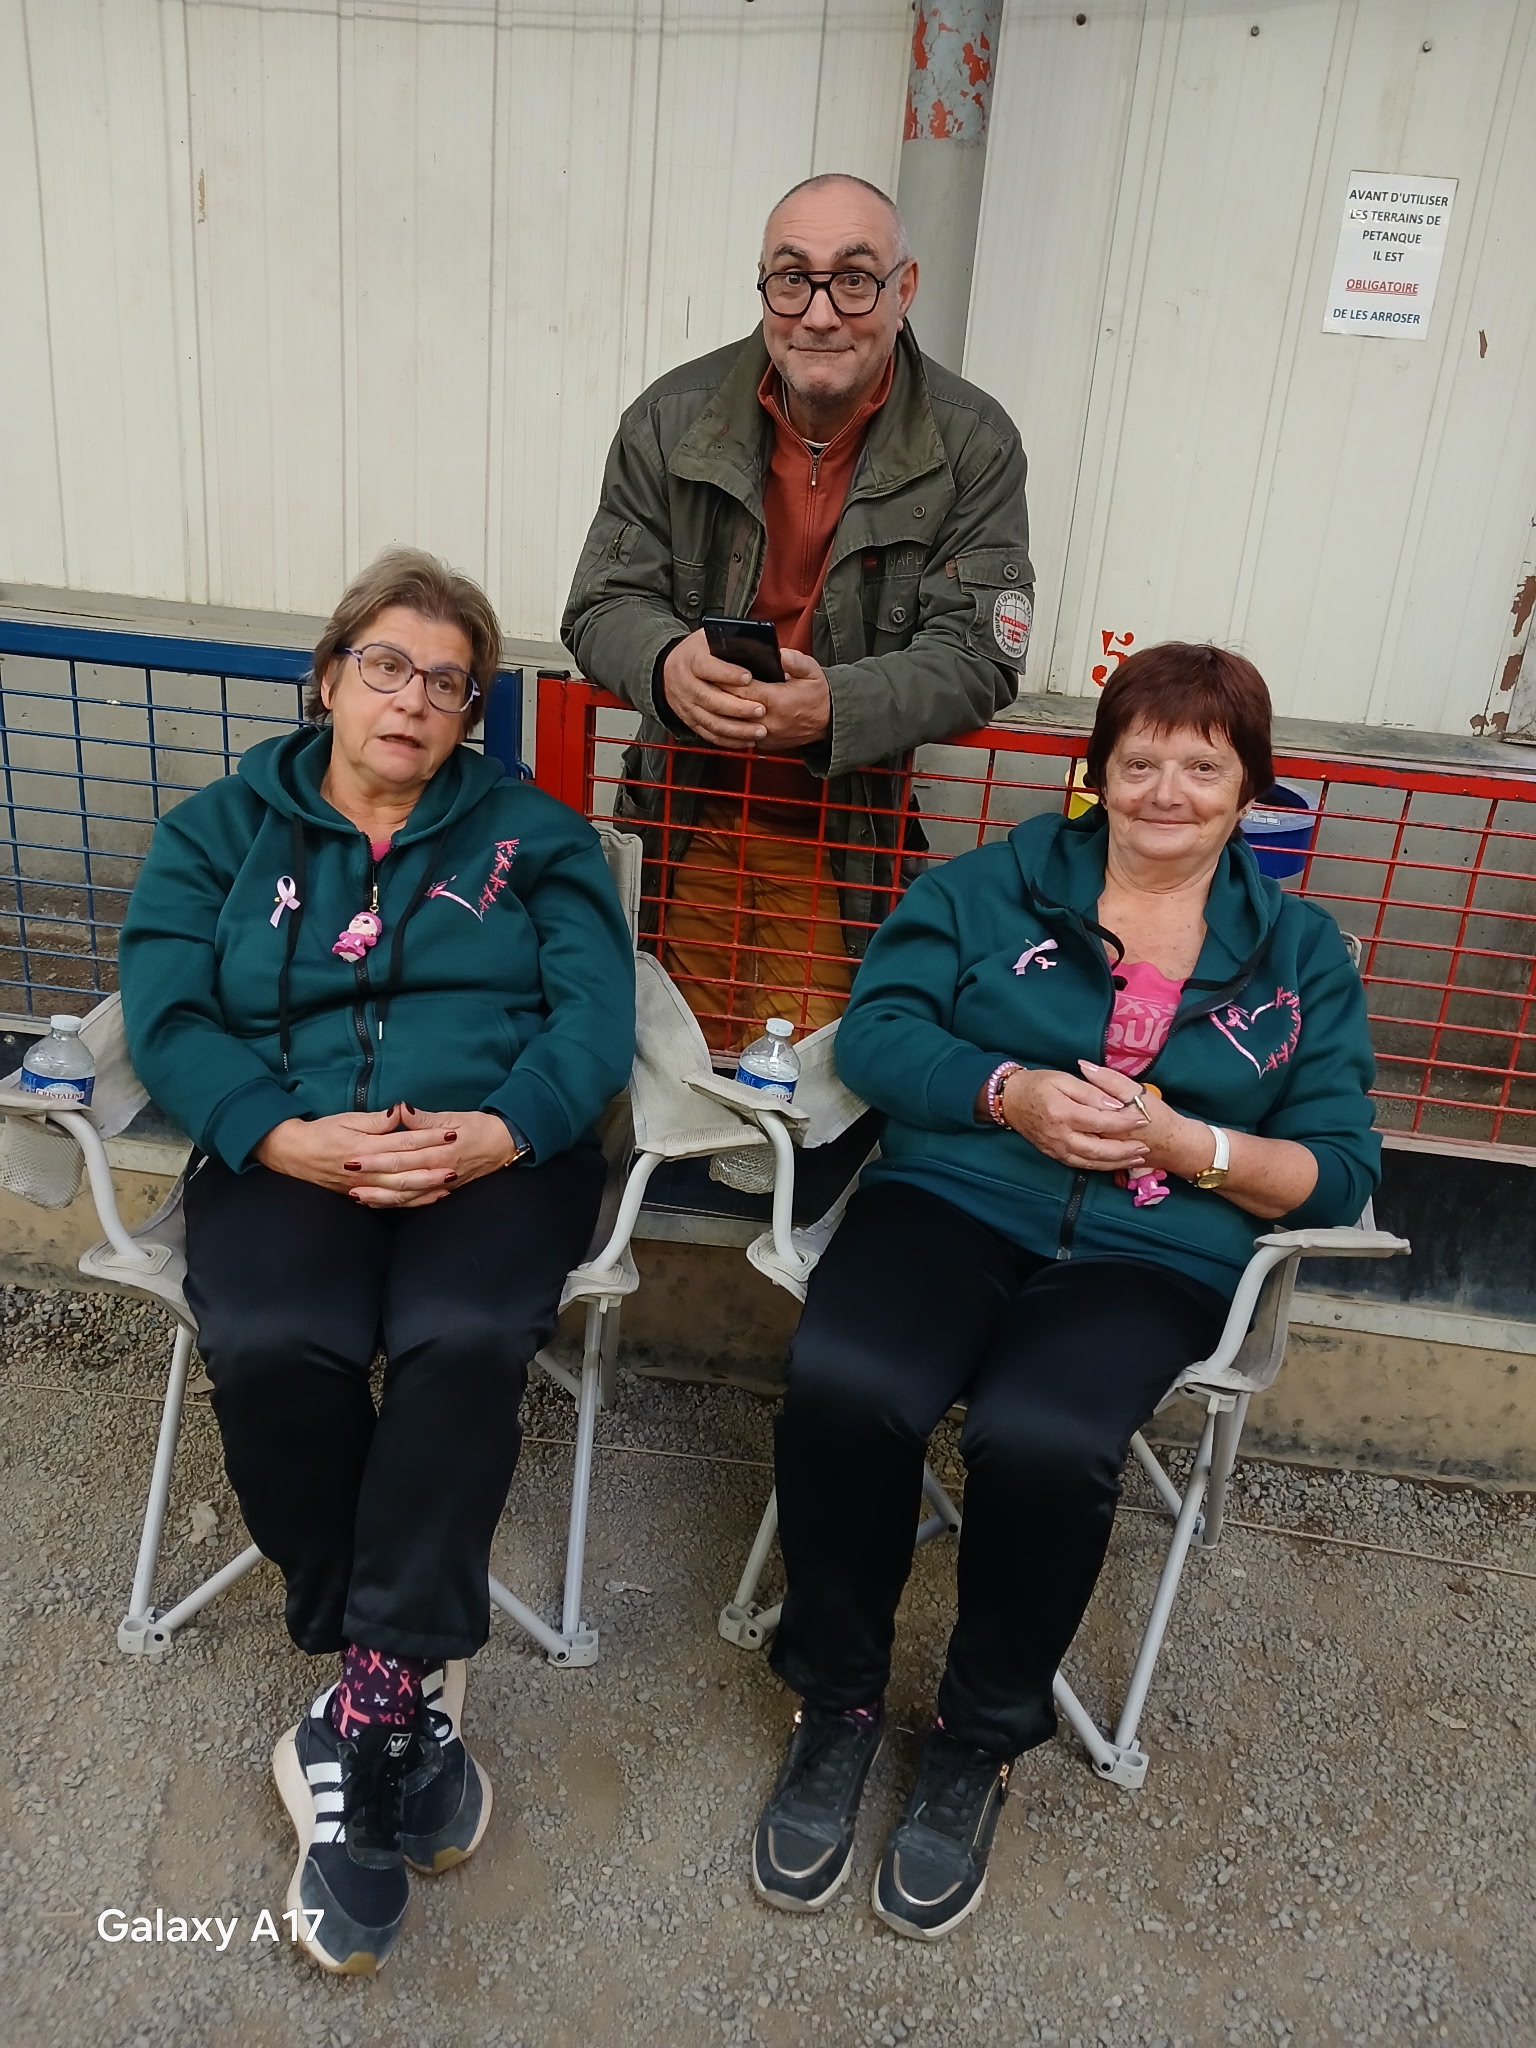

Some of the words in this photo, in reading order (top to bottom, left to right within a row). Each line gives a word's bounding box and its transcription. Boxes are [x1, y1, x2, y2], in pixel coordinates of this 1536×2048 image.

[1349, 190, 1388, 202] AVANT
[1390, 192, 1449, 207] D'UTILISER
[1350, 209, 1368, 221] LES
[1371, 210, 1424, 225] TERRAINS
[1426, 215, 1442, 226] DE
[1362, 230, 1422, 245] PETANQUE
[1372, 250, 1382, 261] IL
[1384, 251, 1405, 263] EST
[1345, 278, 1419, 296] OBLIGATOIRE
[1333, 308, 1348, 319] DE
[1350, 309, 1368, 321] LES
[1370, 311, 1421, 325] ARROSER
